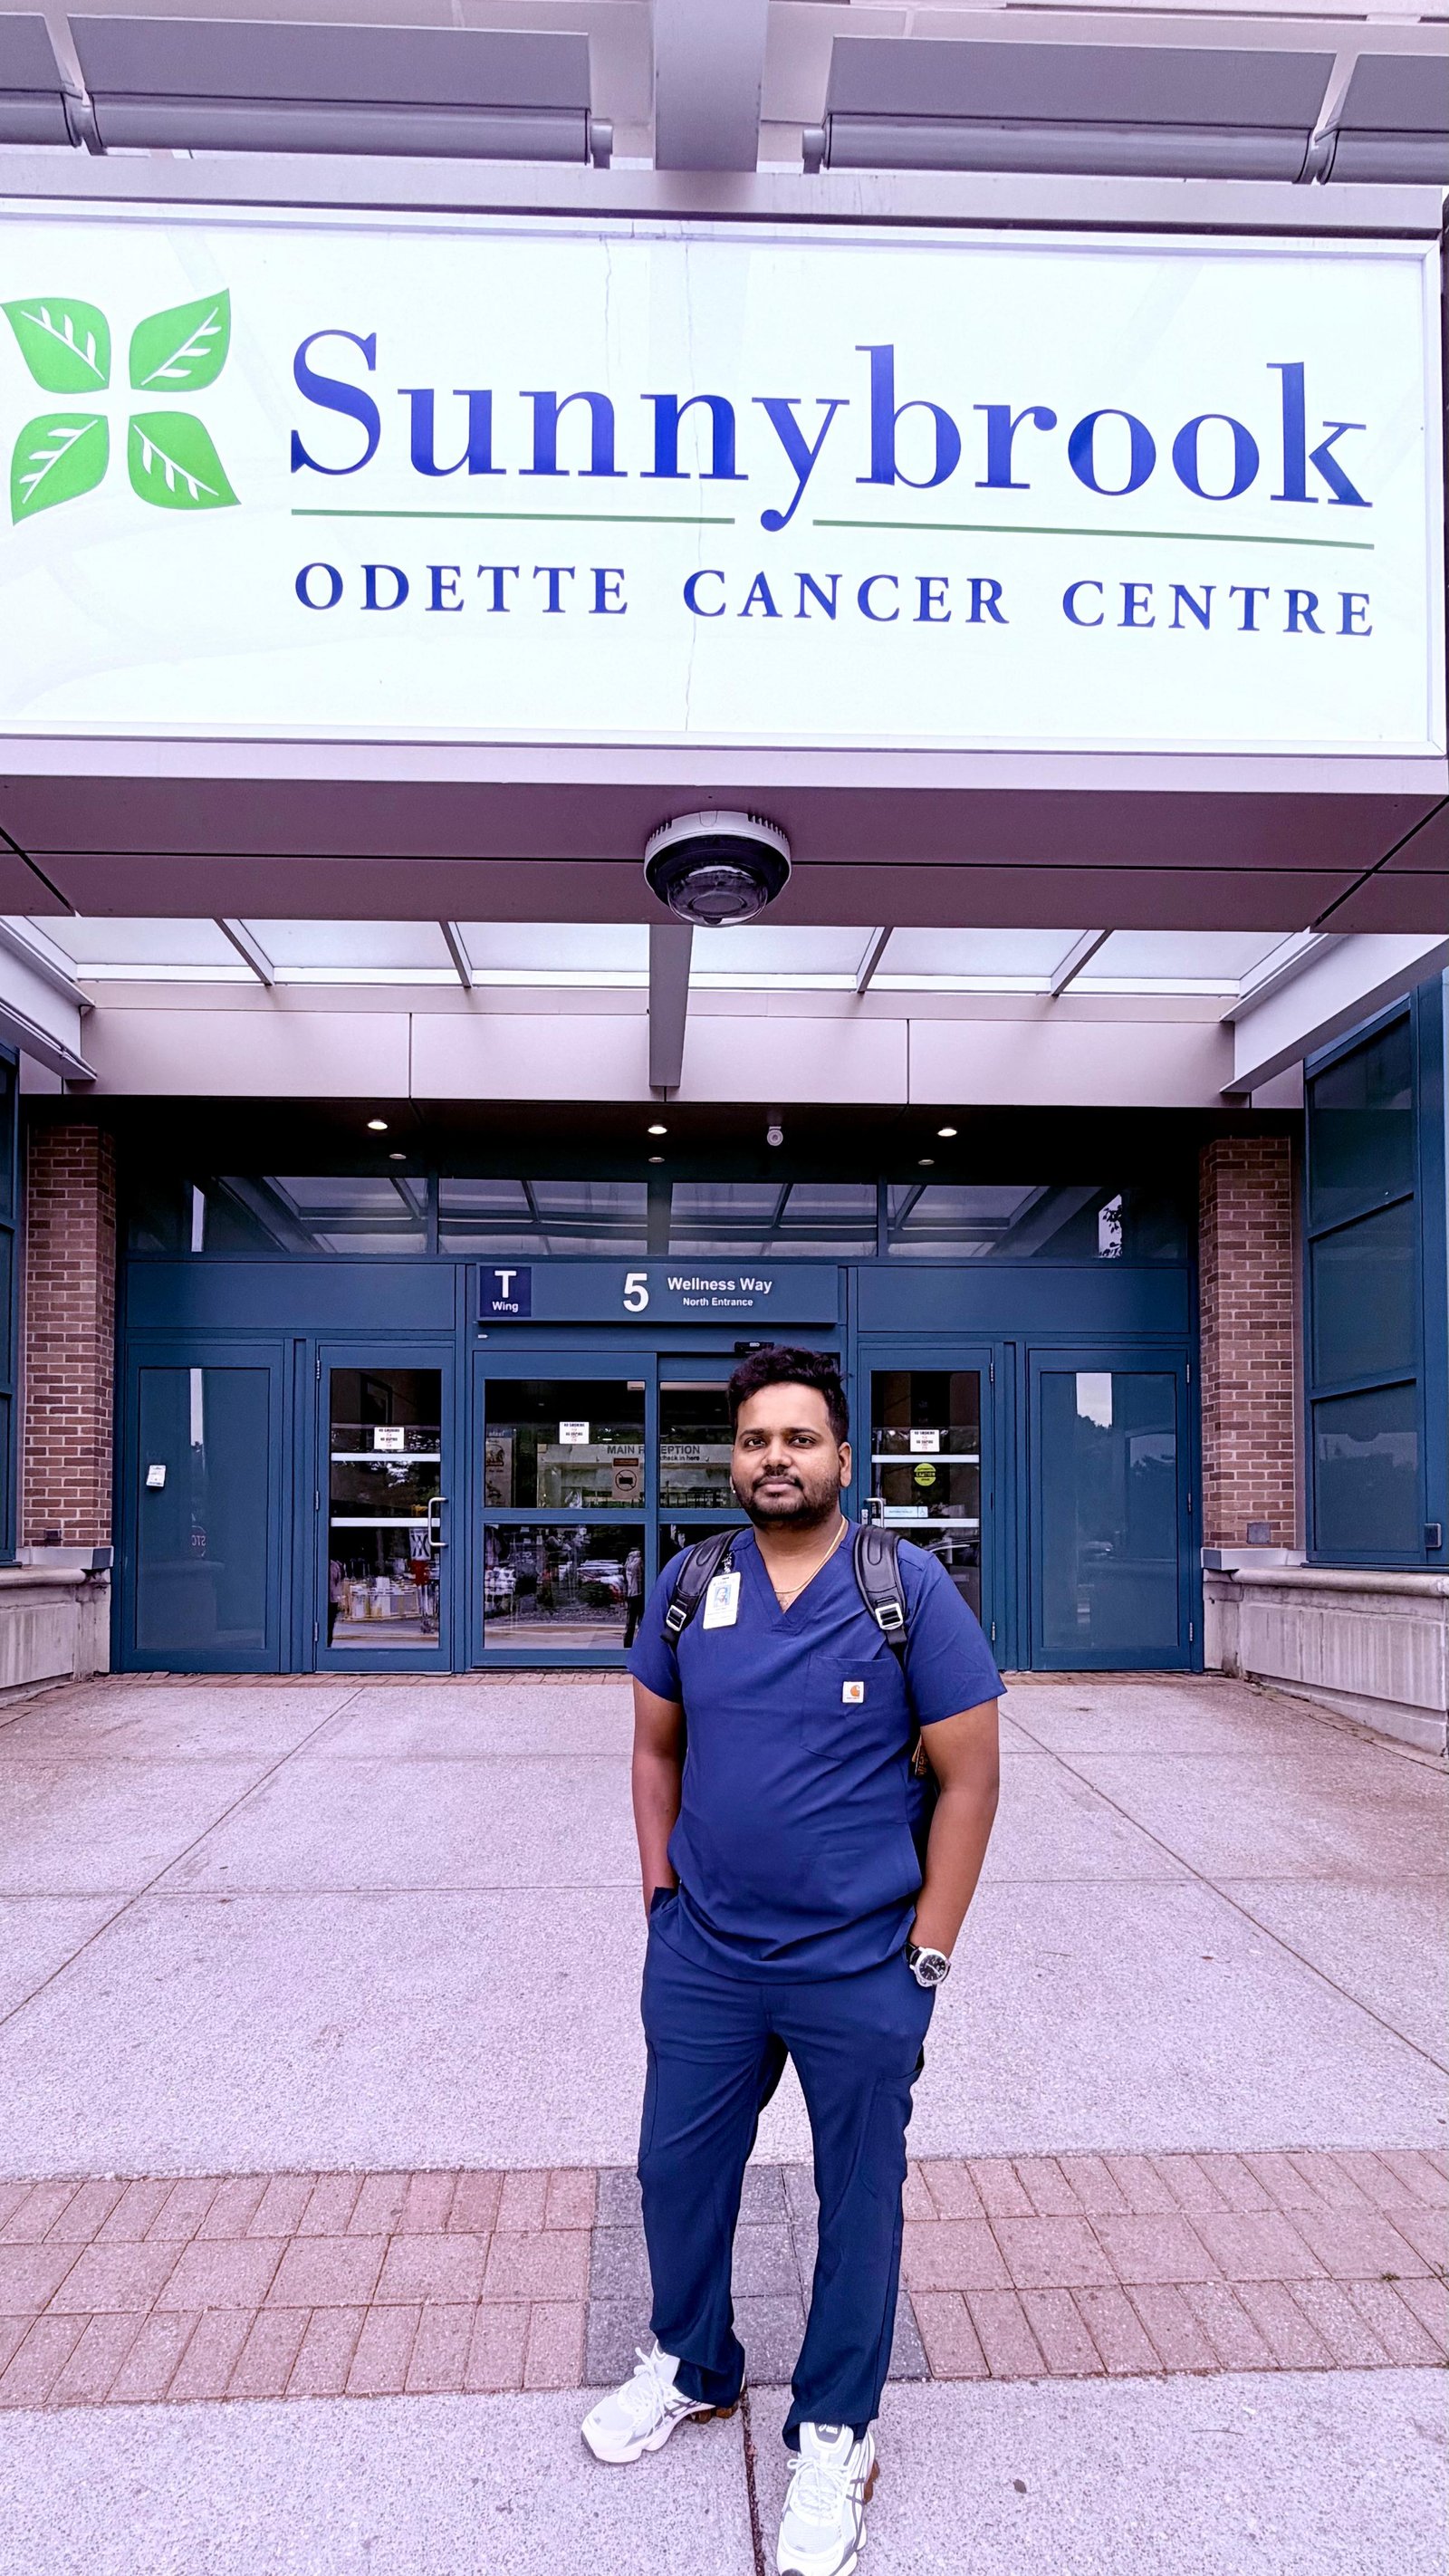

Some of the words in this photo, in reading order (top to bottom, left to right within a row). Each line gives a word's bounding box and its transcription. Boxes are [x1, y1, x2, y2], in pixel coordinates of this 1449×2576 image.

[291, 329, 1373, 532] Sunnybrook
[295, 562, 629, 616] ODETTE
[683, 569, 1010, 625] CANCER
[1062, 580, 1374, 637] CENTRE
[494, 1270, 517, 1298] T
[623, 1273, 649, 1312] 5
[667, 1277, 735, 1291] Wellness
[740, 1277, 772, 1294] Way
[492, 1301, 519, 1313] Wing
[683, 1297, 709, 1306] North
[711, 1297, 753, 1307] Entrance
[607, 1445, 635, 1455] MAIN
[638, 1445, 700, 1455] REPTION
